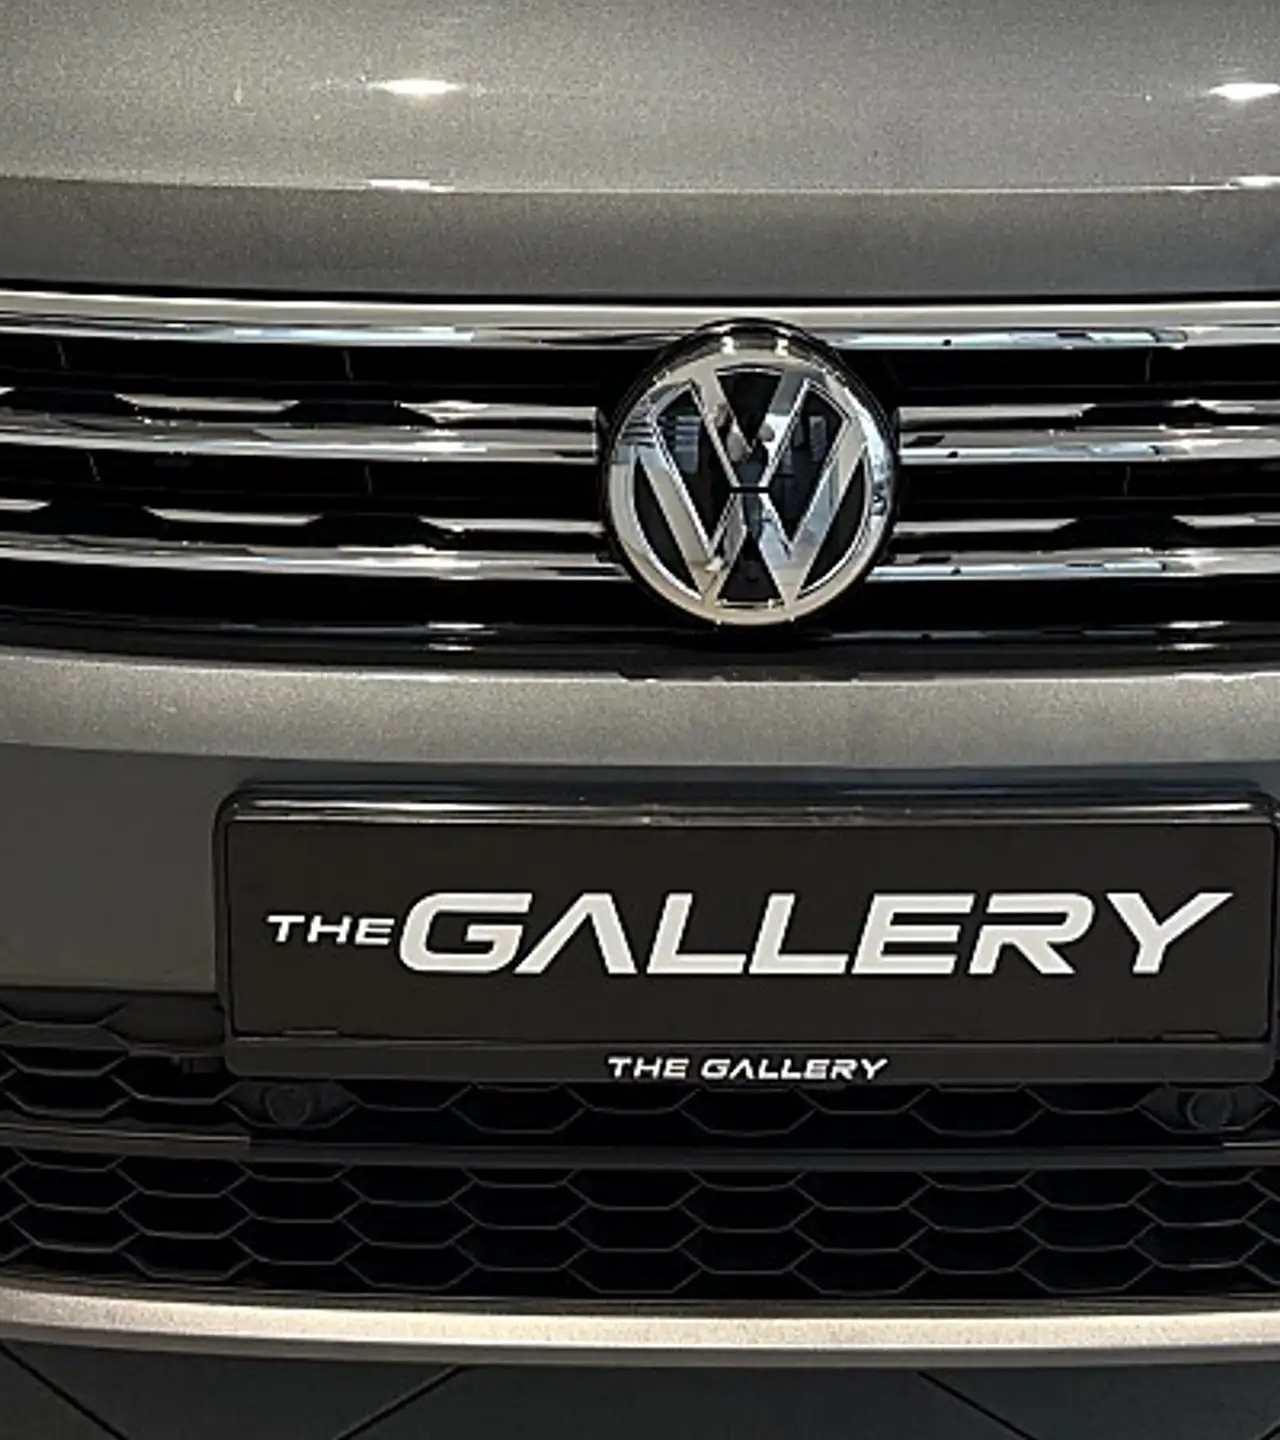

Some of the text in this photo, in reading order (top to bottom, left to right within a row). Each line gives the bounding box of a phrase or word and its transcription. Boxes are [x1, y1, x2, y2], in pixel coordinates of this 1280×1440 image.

[268, 893, 1234, 976] THE GALLERY
[609, 1057, 889, 1082] THE GALLERY
